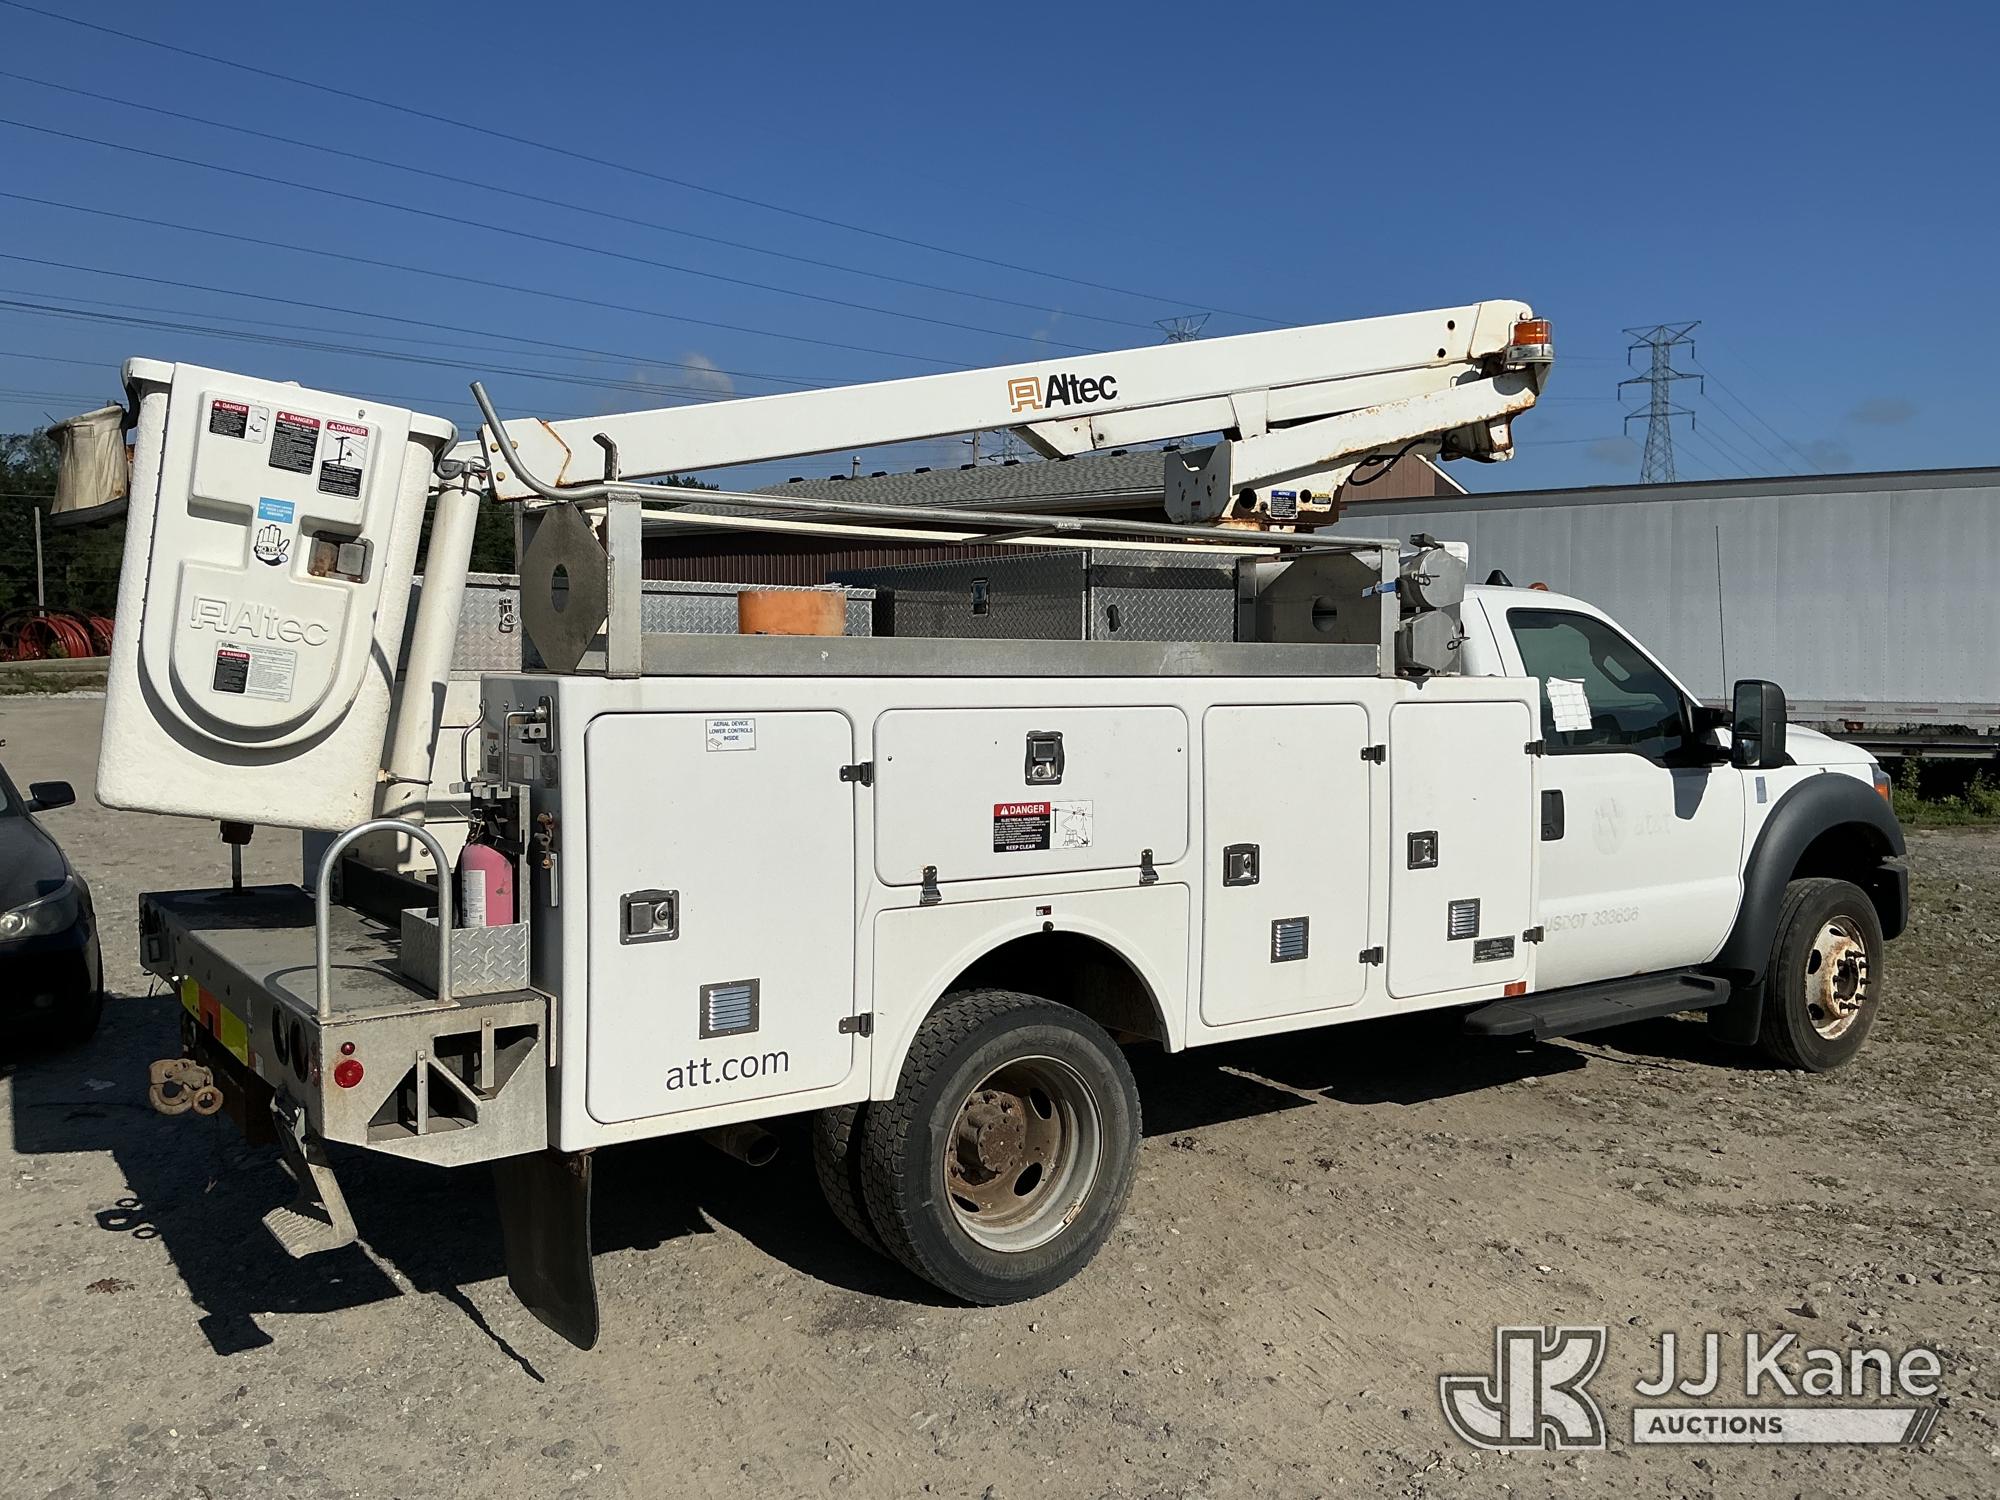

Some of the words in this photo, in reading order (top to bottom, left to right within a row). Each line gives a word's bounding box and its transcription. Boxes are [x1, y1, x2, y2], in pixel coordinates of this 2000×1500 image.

[1044, 373, 1118, 409] Altec
[222, 402, 247, 412] DANGER
[289, 414, 314, 425] DANGER
[336, 424, 366, 436] DANGER
[229, 601, 329, 647] Altec
[1009, 804, 1045, 815] DANGER
[666, 1050, 789, 1091] att.com
